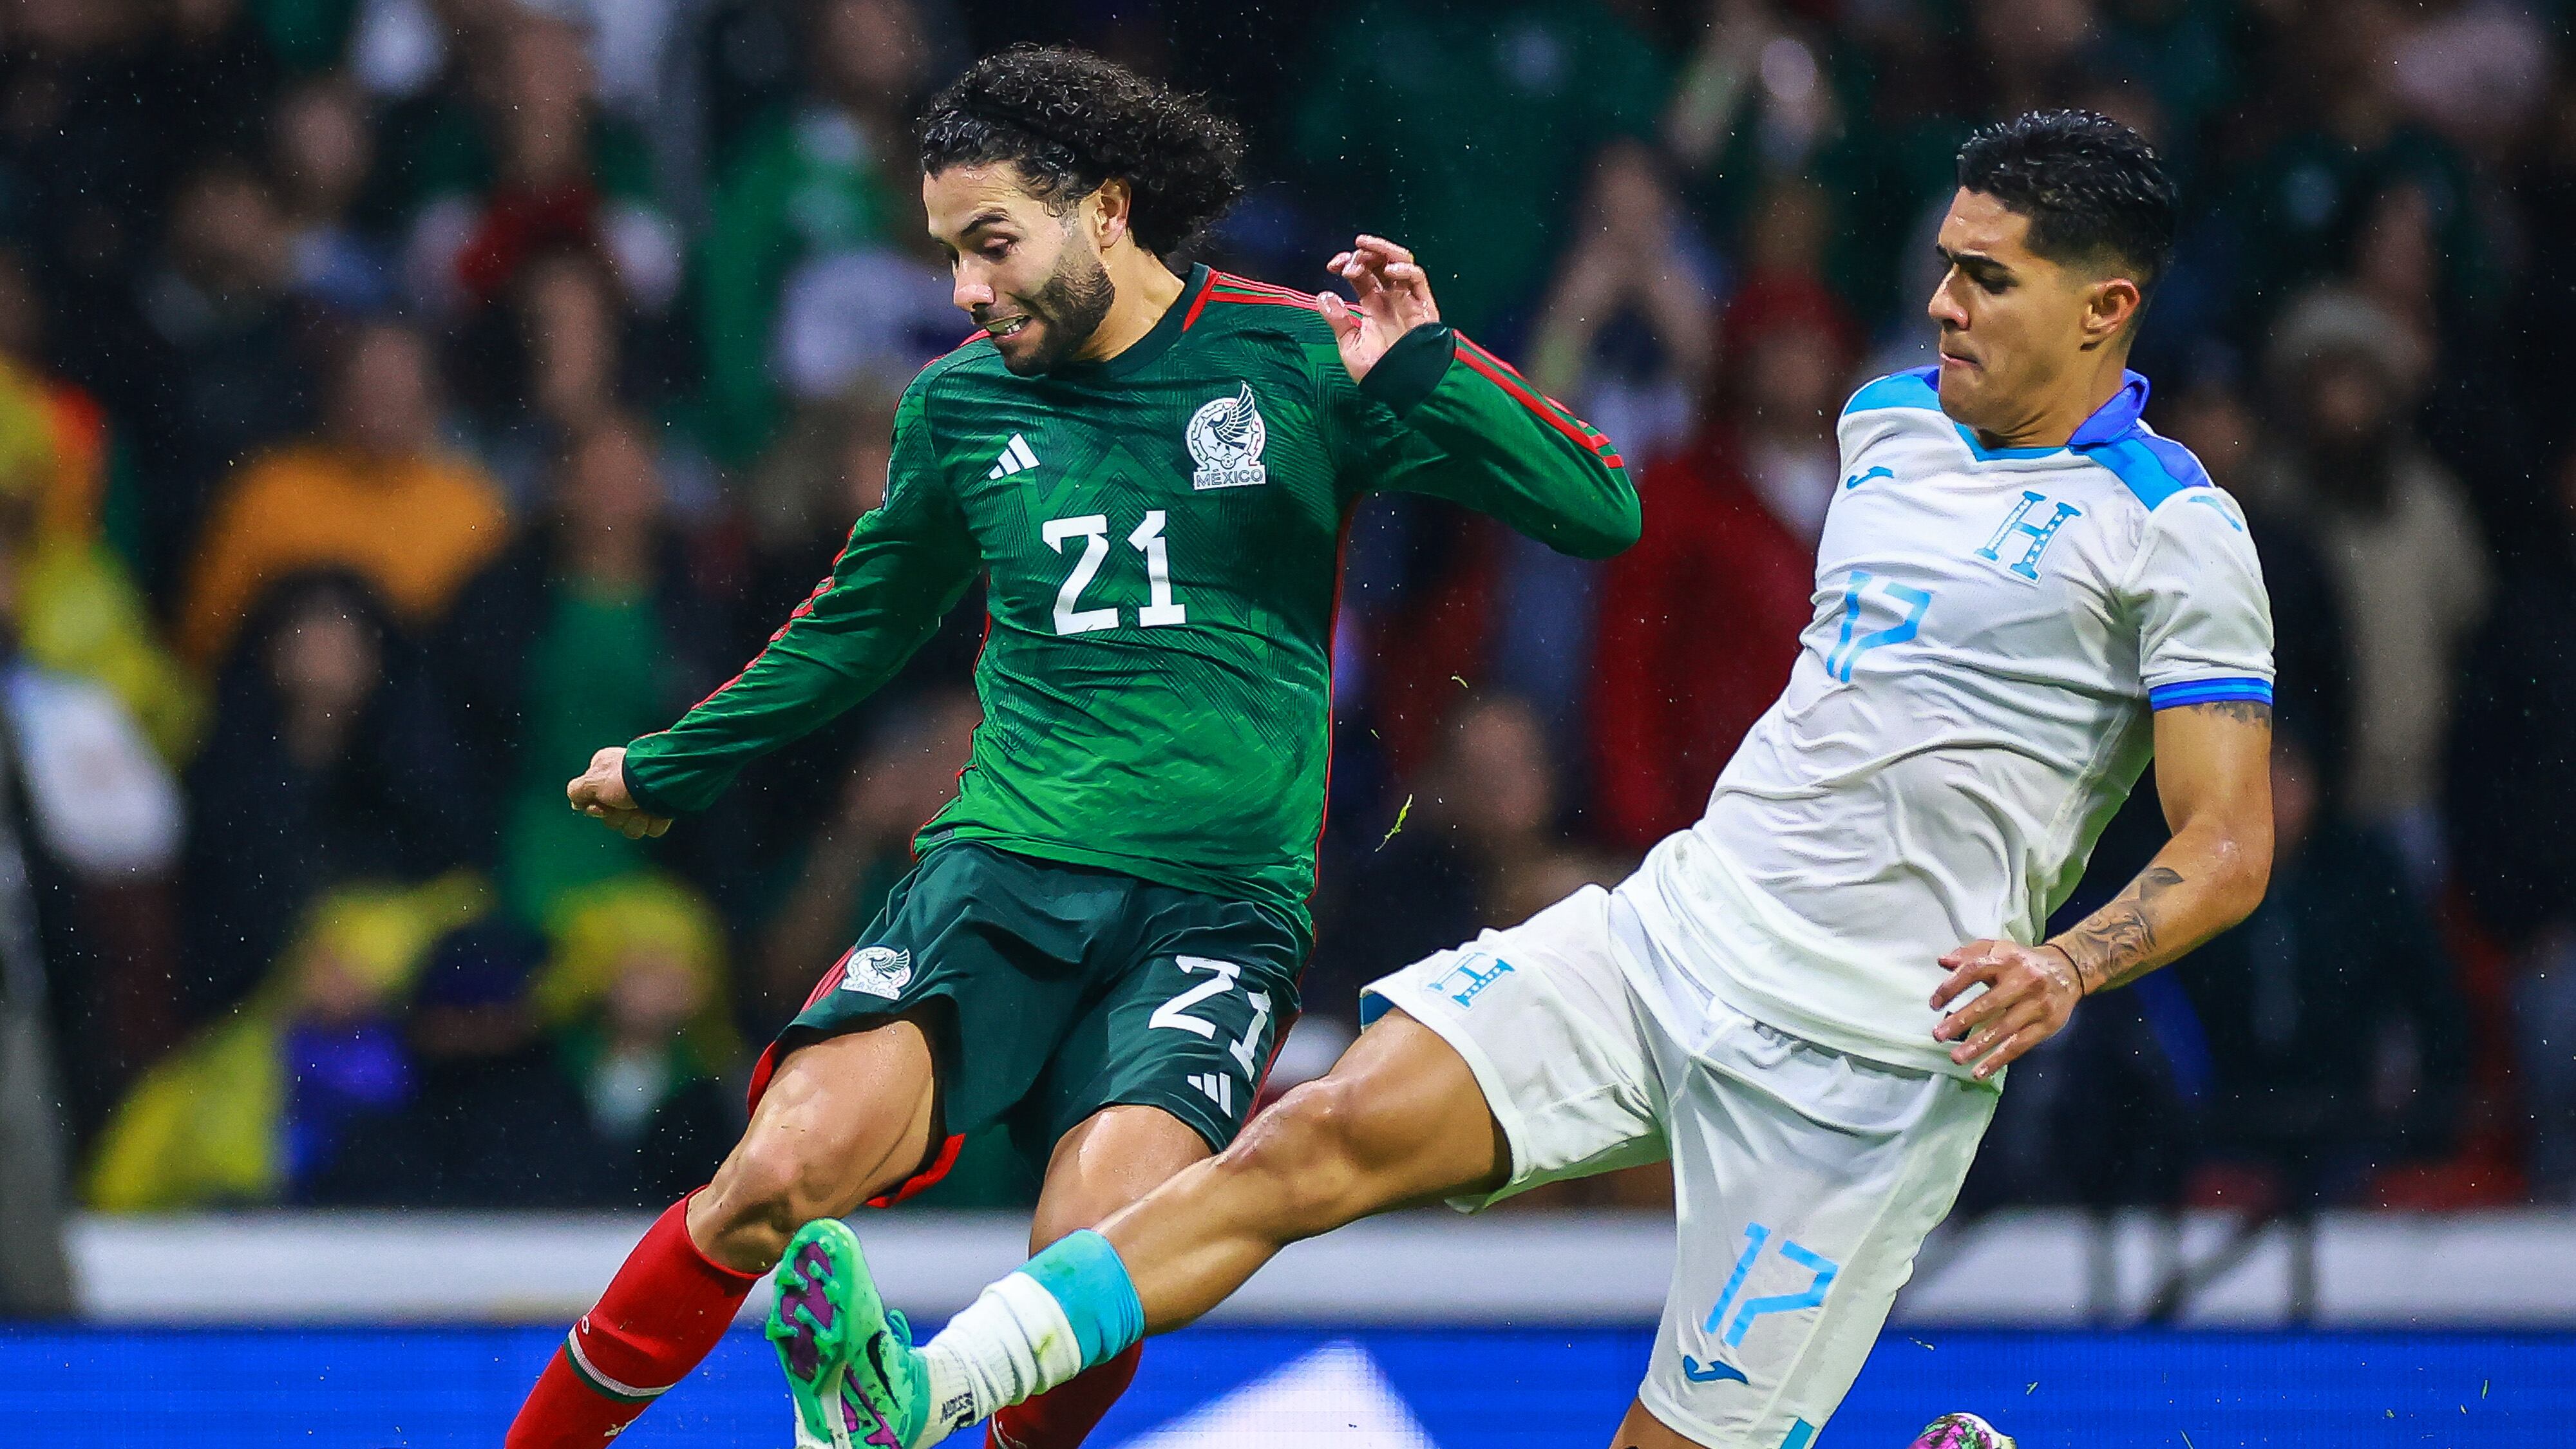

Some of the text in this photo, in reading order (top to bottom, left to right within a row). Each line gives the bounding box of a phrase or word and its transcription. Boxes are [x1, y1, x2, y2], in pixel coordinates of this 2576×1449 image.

[1196, 468, 1264, 488] MÉXICO
[1973, 489, 2083, 581] H
[1041, 509, 1187, 636] 21
[1826, 569, 1932, 684] 17
[1148, 954, 1273, 1083] 21
[1427, 952, 1516, 1008] H
[1703, 1222, 1839, 1349] 17
